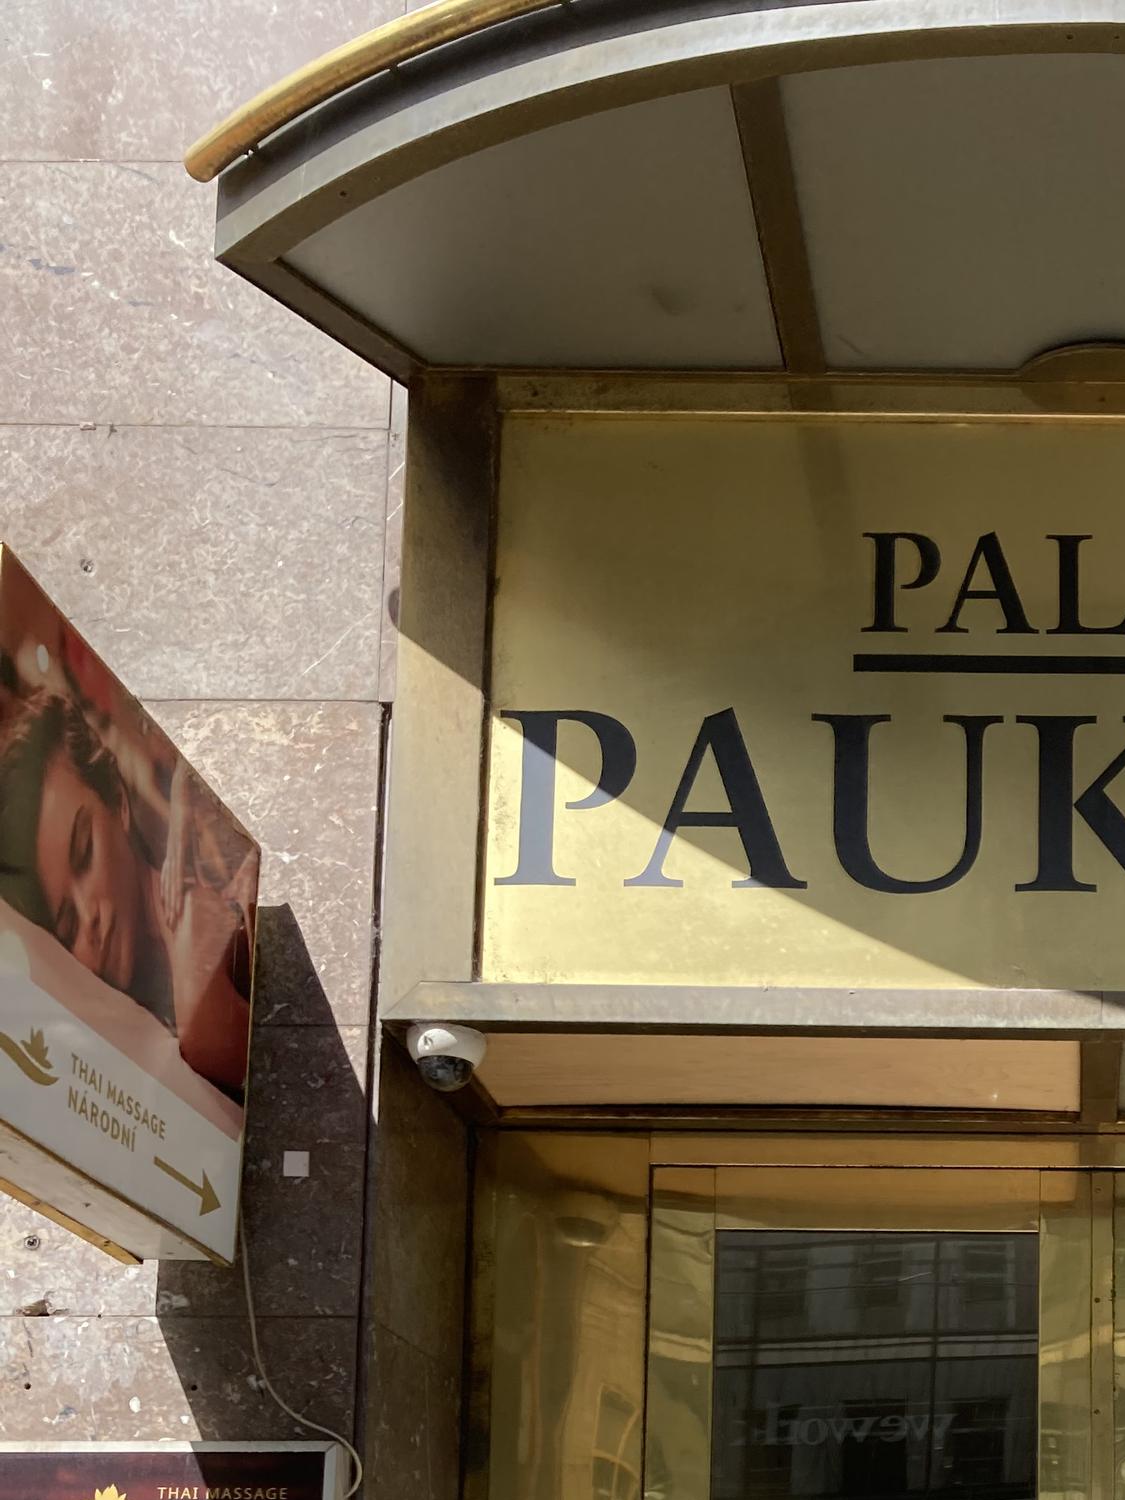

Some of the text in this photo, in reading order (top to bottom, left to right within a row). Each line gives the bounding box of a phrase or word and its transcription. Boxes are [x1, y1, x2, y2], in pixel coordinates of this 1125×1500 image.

[67, 1085, 137, 1152] NÁRODNÍ
[71, 1052, 167, 1141] THAI MASSAGE
[157, 1486, 289, 1500] THAI MASSAGE
